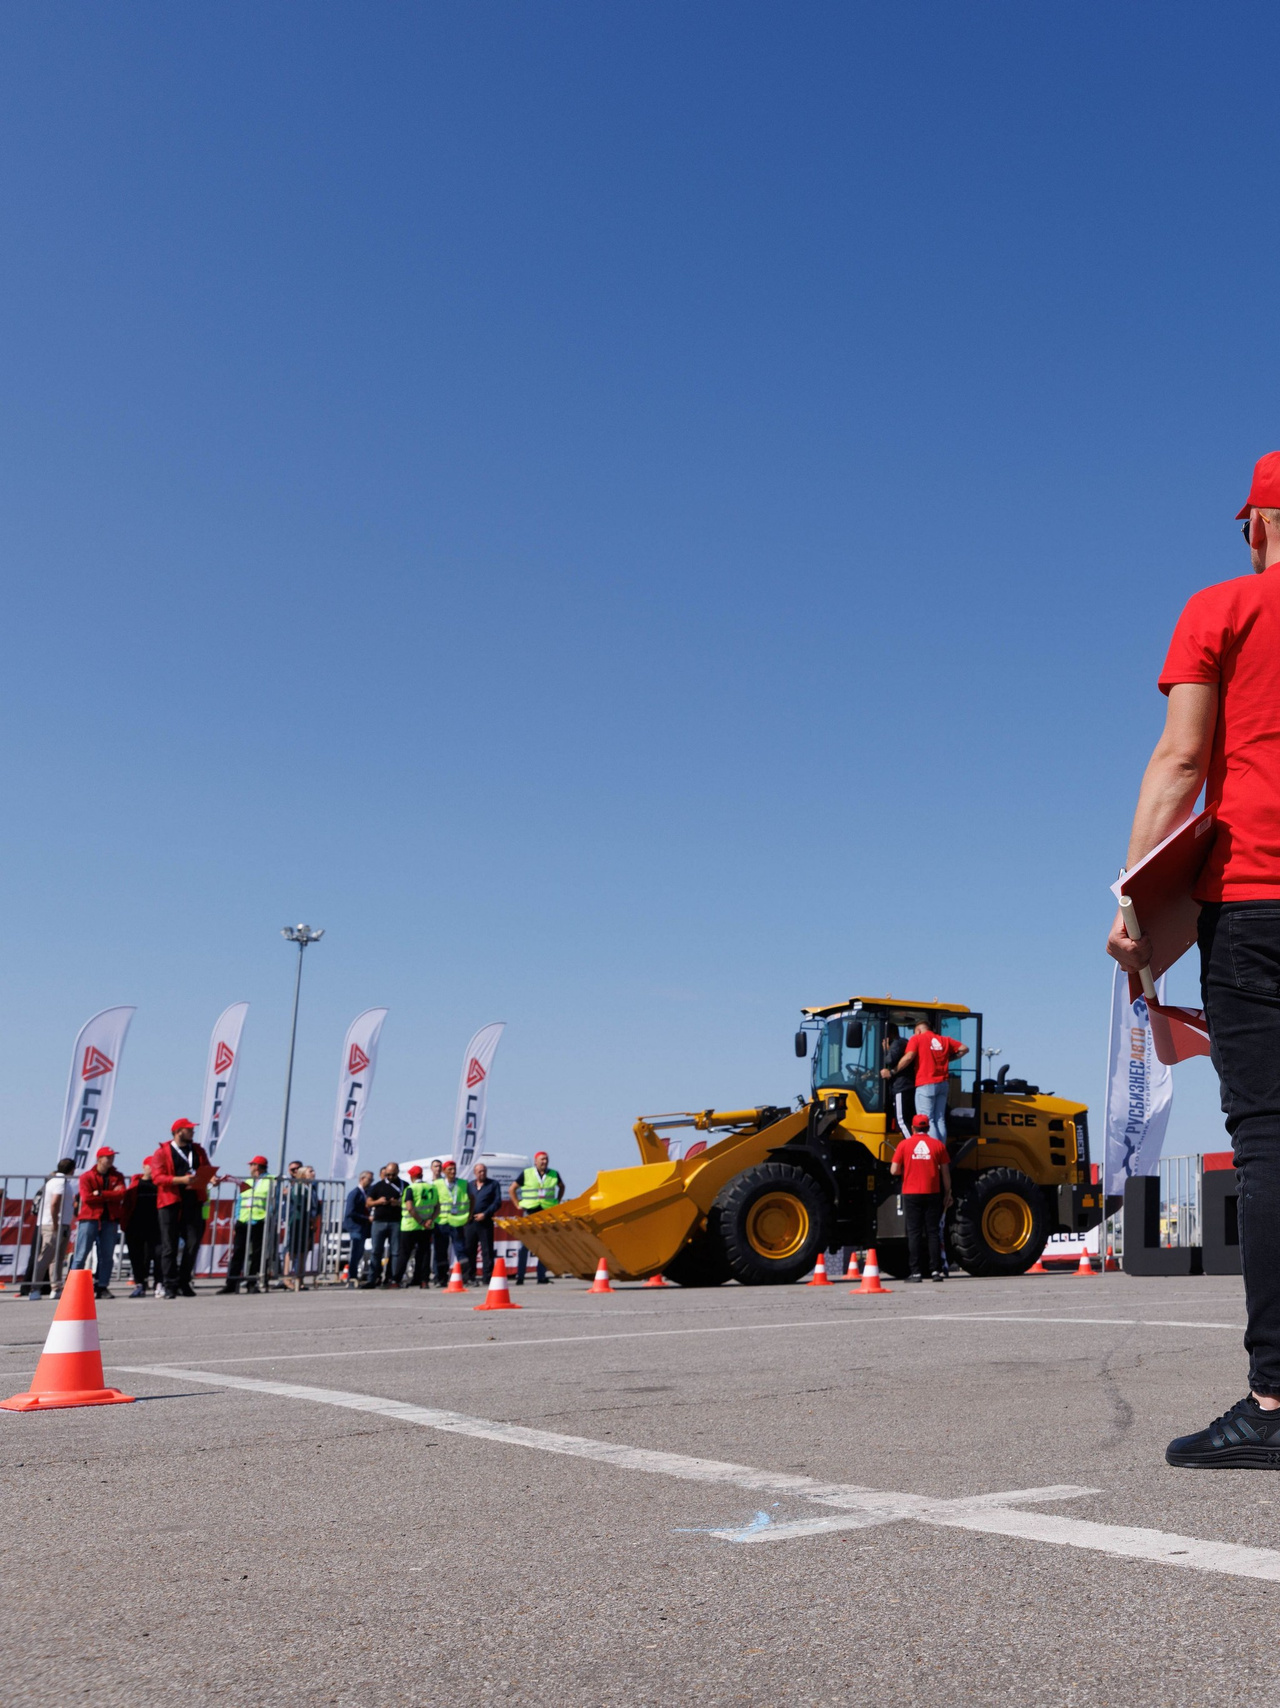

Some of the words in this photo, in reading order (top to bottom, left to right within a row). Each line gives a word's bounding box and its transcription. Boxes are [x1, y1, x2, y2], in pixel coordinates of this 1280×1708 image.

[1132, 994, 1149, 1022] 3
[1124, 1027, 1146, 1135] РУСБИЗНЕСАВТО
[984, 1112, 1037, 1127] LGCE
